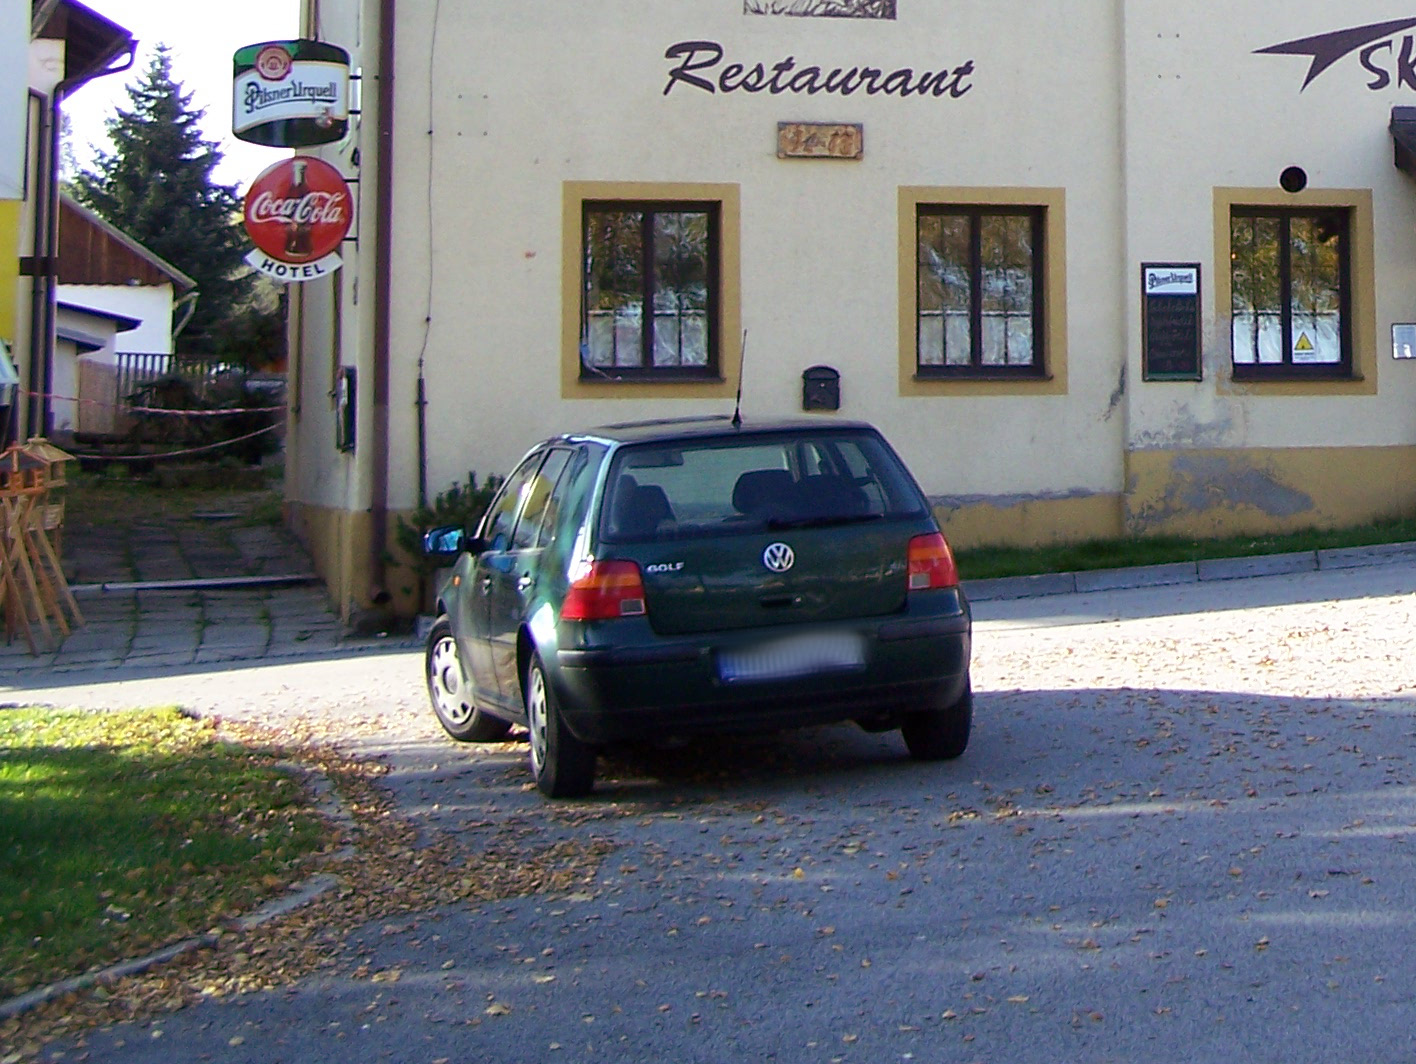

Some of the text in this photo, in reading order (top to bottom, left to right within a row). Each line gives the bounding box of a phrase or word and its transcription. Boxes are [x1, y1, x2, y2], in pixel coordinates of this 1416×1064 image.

[662, 40, 976, 99] Restaurant
[244, 80, 338, 114] Pilsner Urquell
[250, 190, 347, 224] Coca-Cola
[260, 258, 326, 278] HOTEL
[646, 560, 685, 573] GOLF
